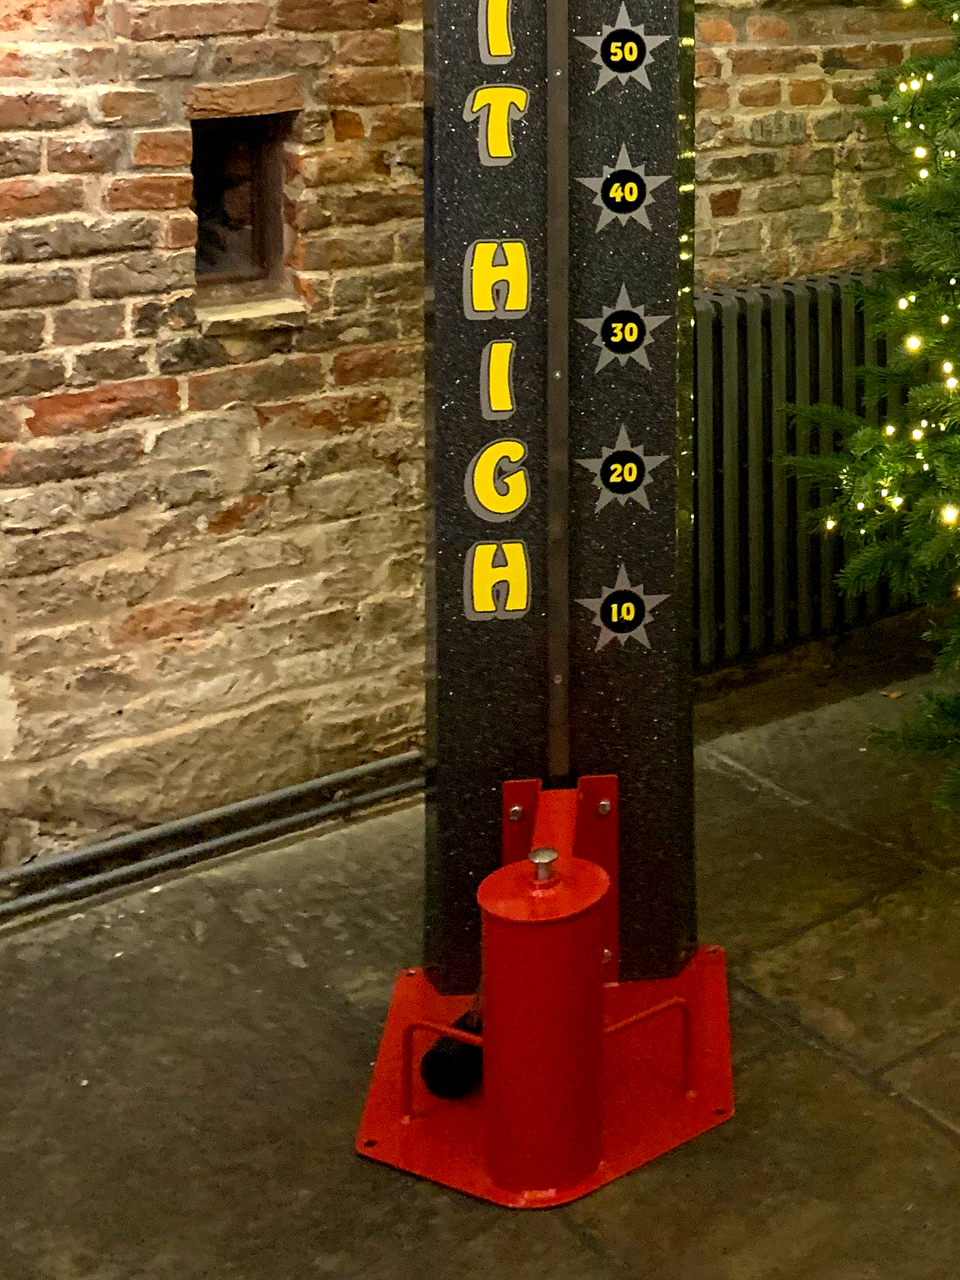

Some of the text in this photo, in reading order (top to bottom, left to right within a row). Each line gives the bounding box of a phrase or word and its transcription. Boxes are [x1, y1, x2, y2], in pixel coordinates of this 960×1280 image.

[609, 41, 638, 62] 50
[608, 182, 639, 203] 40
[610, 322, 639, 343] 30
[462, 238, 532, 621] HIGH
[609, 462, 638, 483] 20
[610, 601, 635, 622] 10
